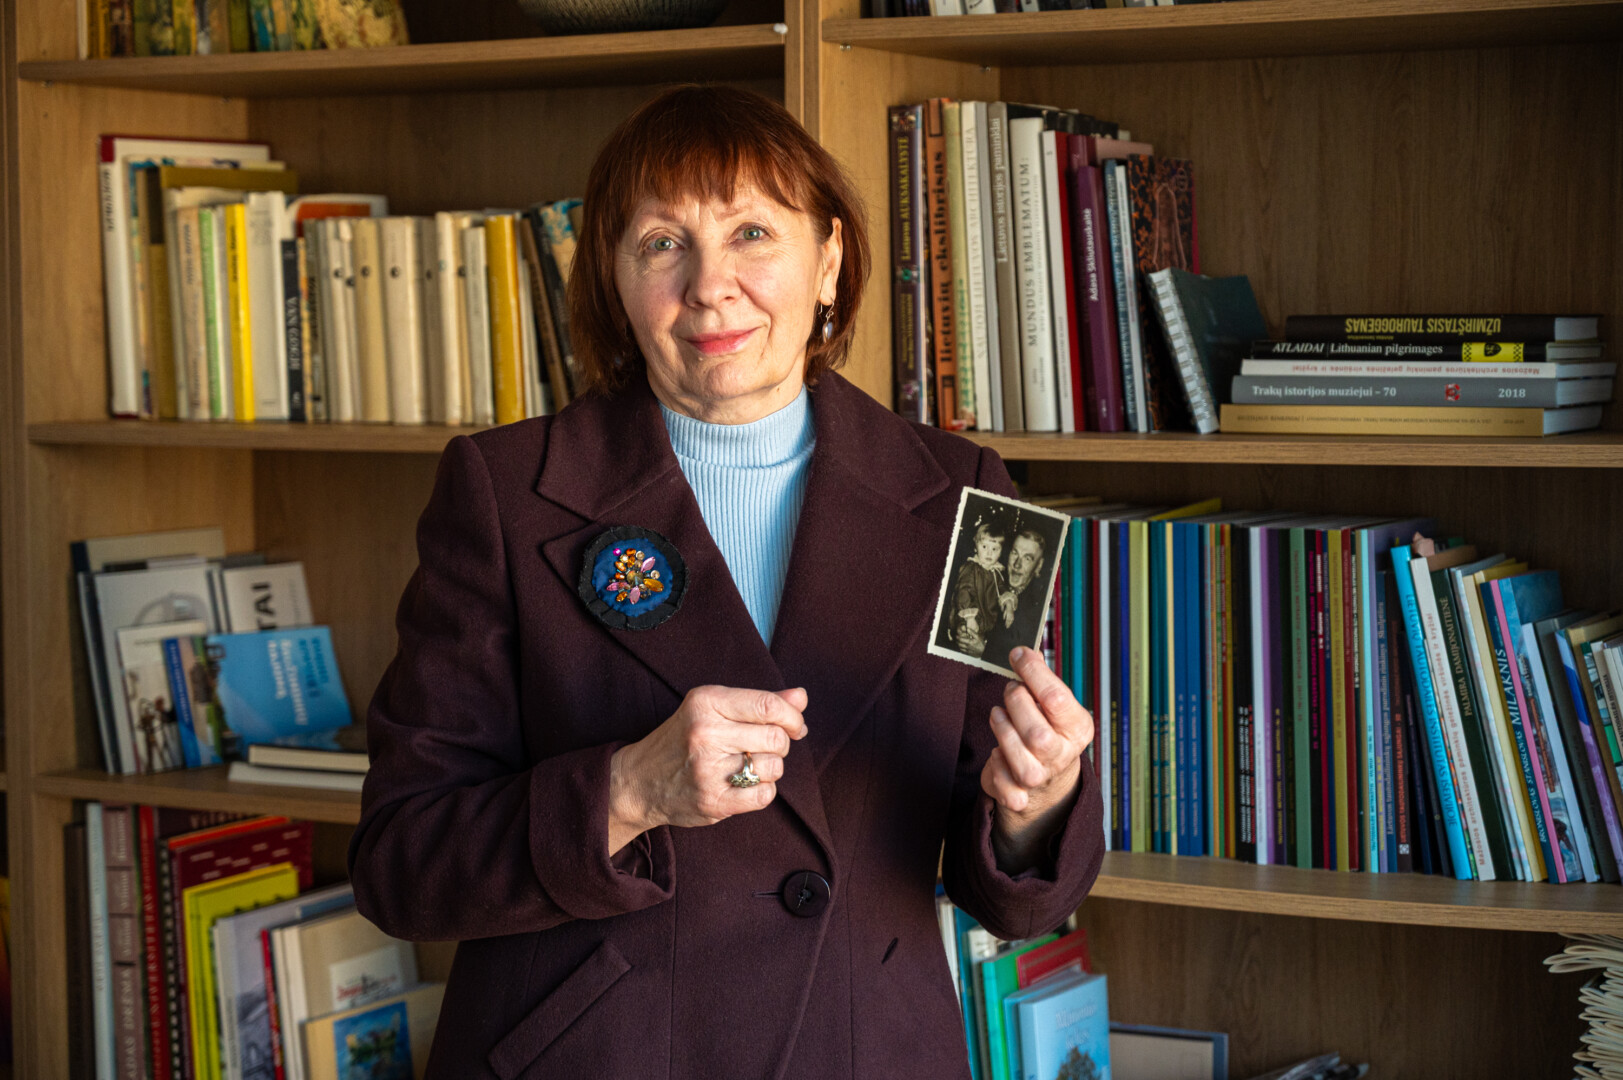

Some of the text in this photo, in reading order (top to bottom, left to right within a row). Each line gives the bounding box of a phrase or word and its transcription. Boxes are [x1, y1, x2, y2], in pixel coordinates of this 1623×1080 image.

[989, 117, 1008, 263] Lietuvos istorijos paminklai
[929, 150, 955, 363] lietuvių ekslibrisas
[1087, 272, 1099, 301] Adasa
[1023, 278, 1038, 346] MUNDUS
[1344, 317, 1501, 334] UŽMIRŠTASIS TAUROGGENAS
[1272, 342, 1442, 355] ATLAIDAI Lithuanian pilgrimages
[1251, 385, 1282, 397] Trakų
[1284, 385, 1326, 397] istorijos
[1328, 386, 1372, 398] muziejui
[1383, 387, 1396, 396] 70
[1498, 388, 1526, 398] 2018
[1424, 611, 1438, 640] kryžiai
[1456, 675, 1473, 717] PALMIRA
[1428, 716, 1449, 778] INSTITUTAS
[1450, 730, 1466, 768] paminklų
[1494, 646, 1547, 843] BRONISLOVAS STANISLOVAS MILAKNIS
[1459, 770, 1477, 824] architektūros
[1471, 827, 1486, 865] Mažosios
